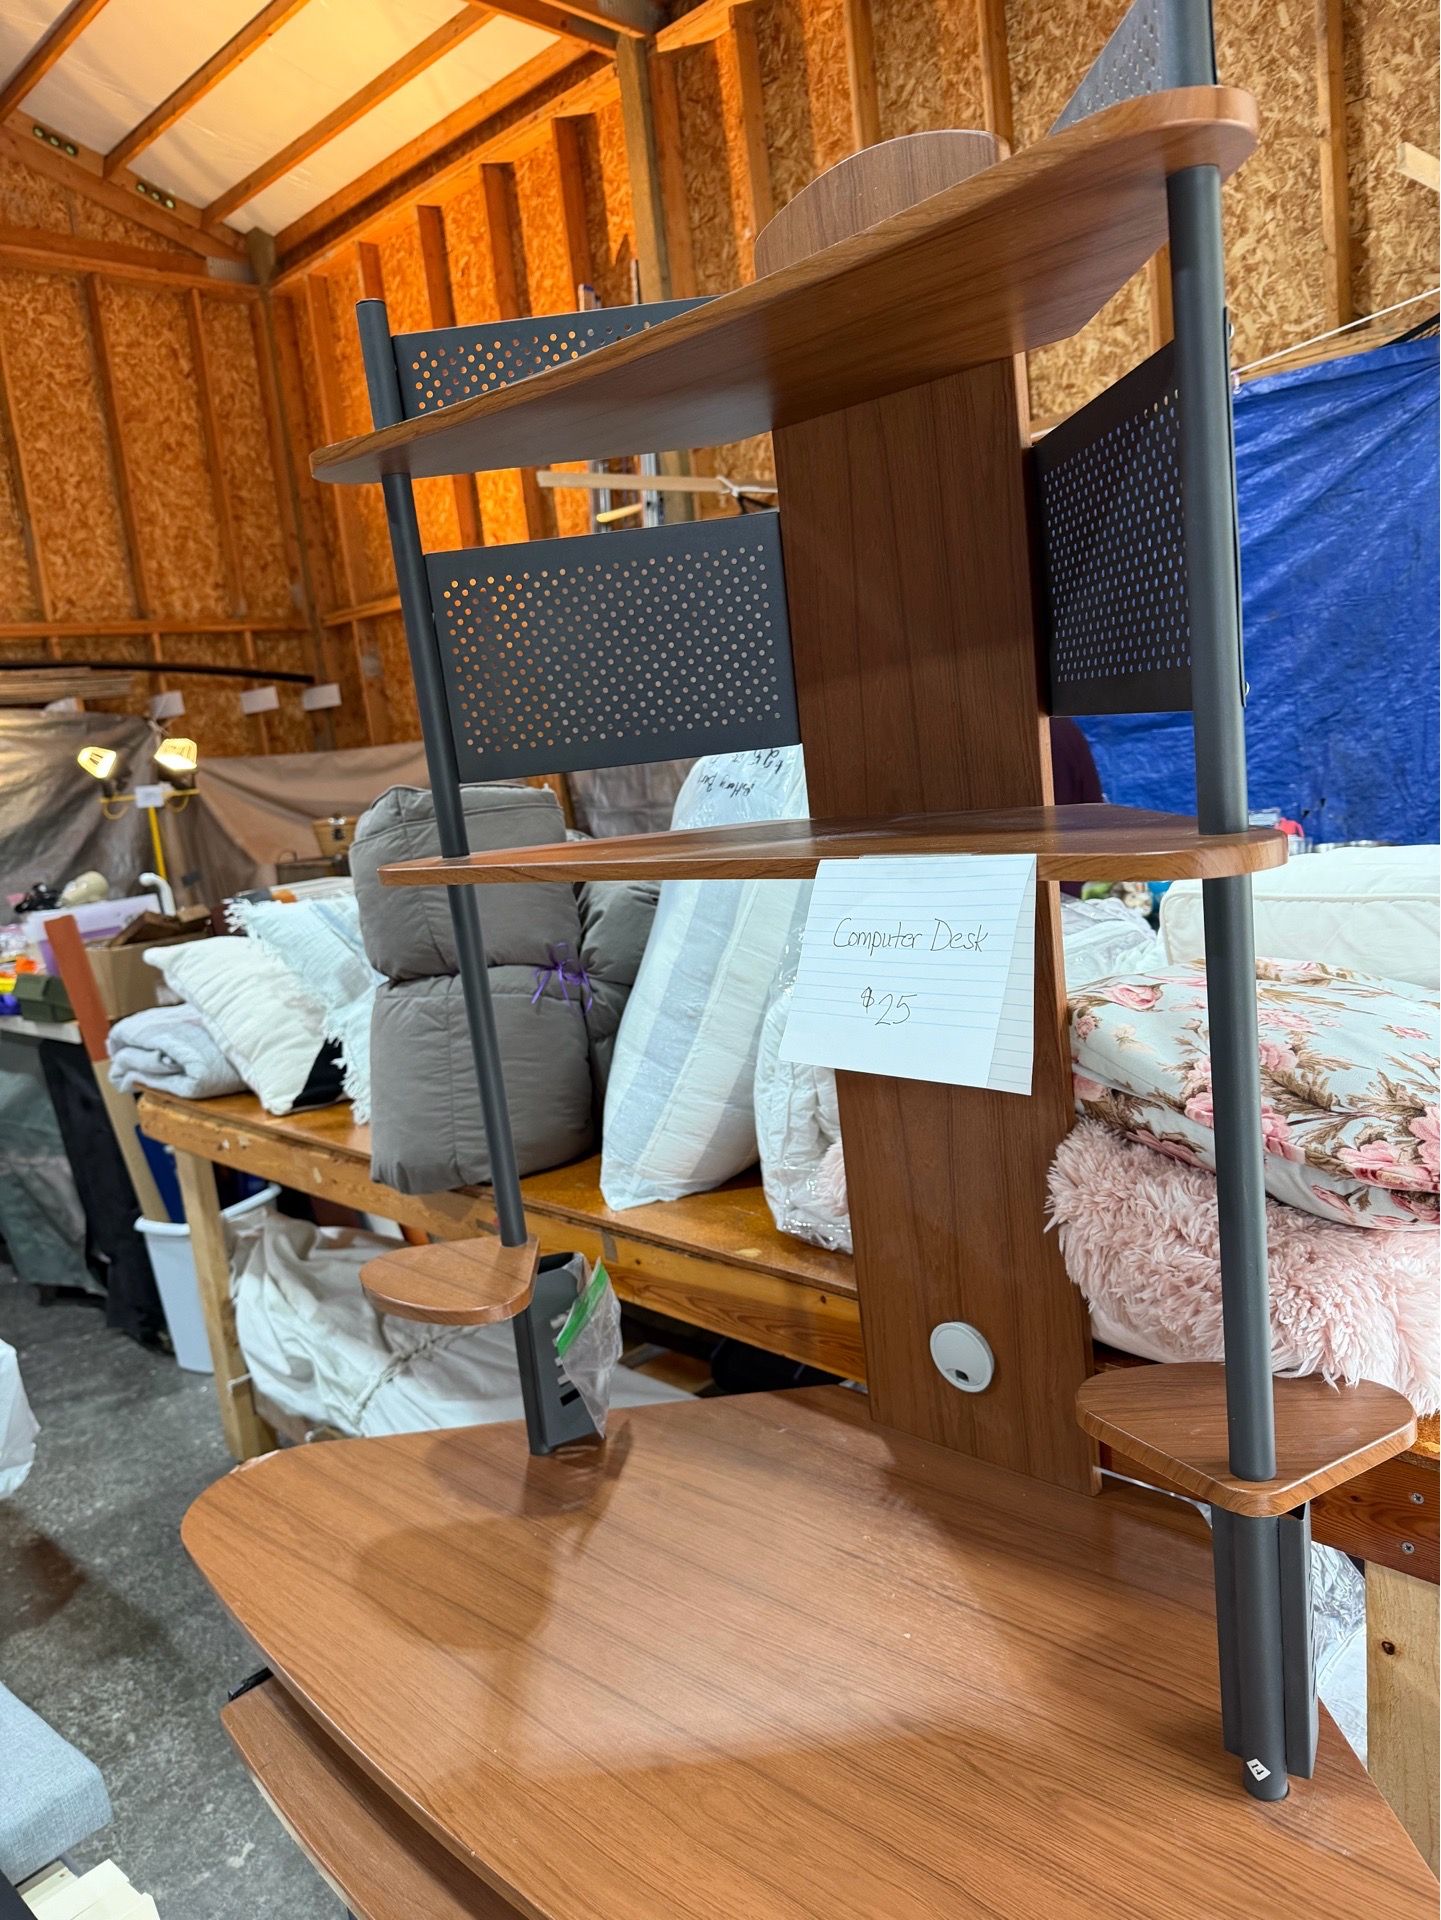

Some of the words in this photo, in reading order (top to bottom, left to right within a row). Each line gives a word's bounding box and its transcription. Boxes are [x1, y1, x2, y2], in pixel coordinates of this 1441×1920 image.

[832, 917, 923, 957] Computer
[930, 918, 989, 953] Desk
[860, 986, 918, 1026] $25
